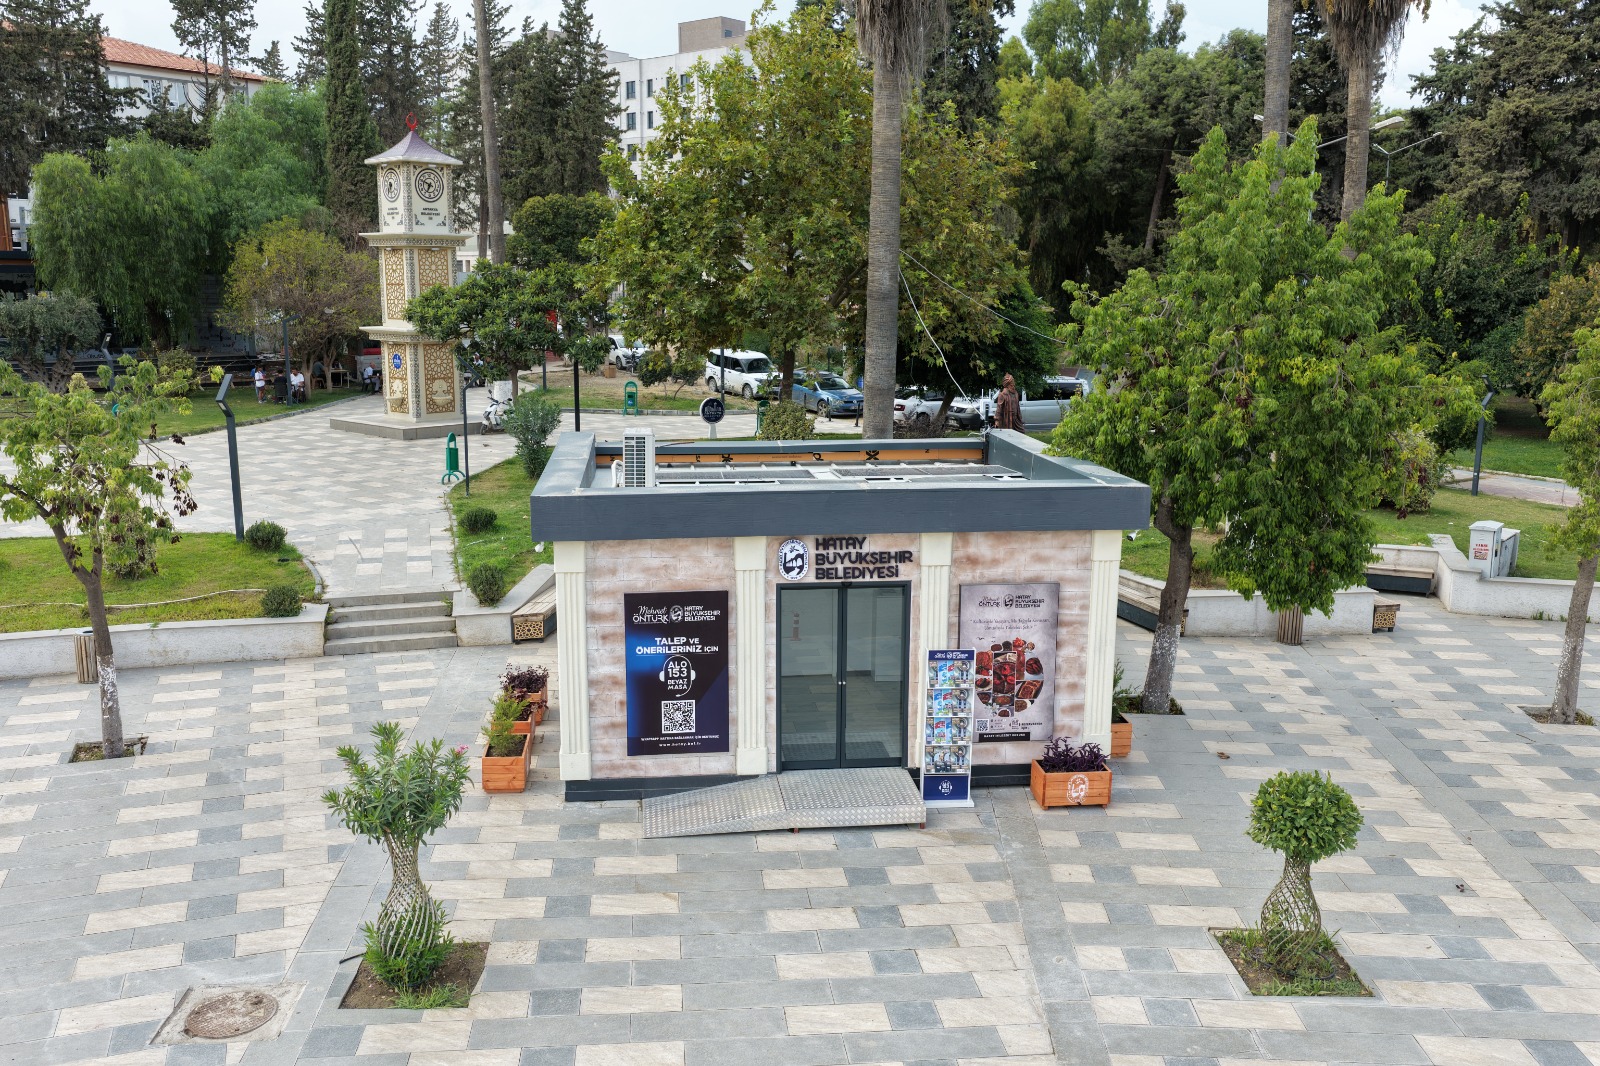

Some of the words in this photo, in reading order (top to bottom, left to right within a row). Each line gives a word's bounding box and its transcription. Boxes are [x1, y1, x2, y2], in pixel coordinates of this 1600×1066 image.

[815, 536, 867, 551] HATAY
[815, 550, 913, 566] BÜYÜKŞEHİR
[815, 565, 899, 580] BELEDİYESİ
[655, 637, 687, 646] TALEP
[635, 645, 702, 655] ÖNERİLERİNİZ
[667, 660, 688, 669] ALO
[667, 668, 688, 678] 153
